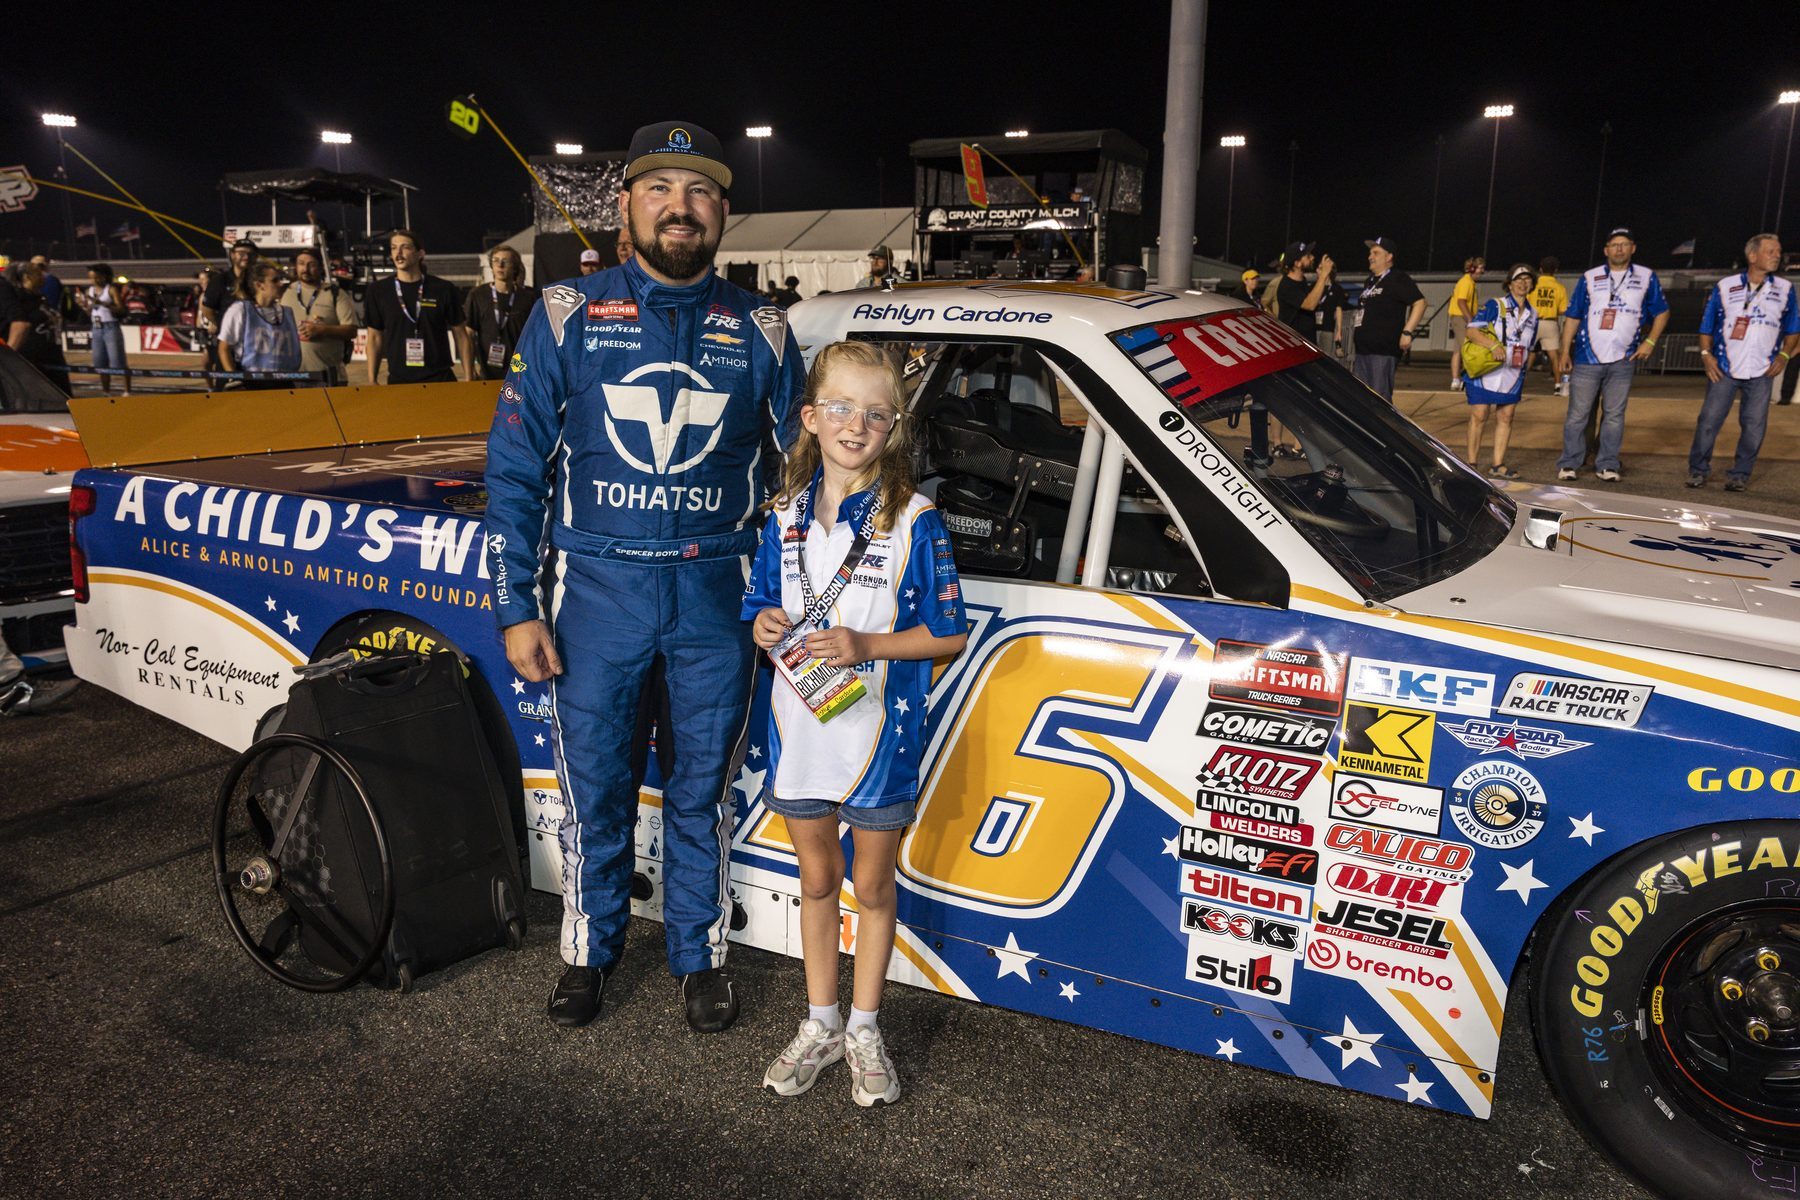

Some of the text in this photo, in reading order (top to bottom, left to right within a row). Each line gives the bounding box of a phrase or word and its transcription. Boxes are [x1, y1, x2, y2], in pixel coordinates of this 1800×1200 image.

[450, 100, 480, 134] 20
[948, 210, 987, 219] GRANT
[989, 209, 1036, 219] COUNTY
[590, 306, 636, 314] CRAFTSMAN
[703, 313, 743, 330] FRE
[853, 303, 1053, 326] Ashlyn Cardone
[144, 329, 164, 350] 17
[585, 324, 642, 334] GOODYEAR
[599, 340, 641, 349] FREEDOM
[699, 343, 747, 354] CHEVROLET
[699, 352, 748, 369] AMTHOR
[1175, 429, 1282, 528] DROPLIGHT
[593, 479, 722, 512] TOHATSU
[114, 477, 146, 526] A
[162, 481, 399, 564] CHILD'S
[946, 514, 991, 530] FREEDOM
[946, 523, 990, 535] WARRANTY
[615, 548, 654, 557] SPENCER
[141, 537, 492, 612] ALICE & ARNOLD AMTHOR FOUNDA
[497, 556, 510, 605] TOHATSU
[853, 574, 888, 586] DESNUDA
[809, 578, 842, 625] NASCAR
[95, 628, 280, 690] Nor-Cal Equipment
[1265, 651, 1308, 665] NASCAR
[138, 667, 246, 706] RENTALS
[1244, 665, 1339, 694] AFTSMAN
[1352, 663, 1488, 707] SKF
[1549, 681, 1631, 706] NASCAR
[1247, 691, 1302, 706] TRUCK SERIES
[1510, 696, 1630, 722] RACE TRUCK
[1203, 711, 1329, 748] COMETIC
[1209, 731, 1257, 743] GASKET
[1463, 735, 1551, 753] RaceCar Bodies
[1464, 724, 1562, 745] FIVE STAR
[1210, 751, 1313, 791] KLOTZ
[1341, 756, 1424, 780] KENNAMETAL
[1462, 764, 1540, 797] CHAMPION
[1248, 785, 1295, 799] SYNTHETICS
[1333, 789, 1439, 818] XCELDYNE
[1201, 792, 1295, 824] LINCOLN
[1220, 815, 1302, 843] WELDERS
[1455, 811, 1537, 846] IRRIGATION
[1182, 827, 1268, 873] Holley
[1325, 825, 1472, 871] CALICO
[1334, 865, 1460, 909] DART
[1396, 862, 1468, 882] COATINGS
[1188, 869, 1303, 915] tilton
[1185, 902, 1299, 952] KOOKS
[1318, 900, 1453, 949] JESEL
[1571, 837, 1800, 1018] GOODYEA
[1325, 926, 1436, 957] SHAFT ROCKER ARMS
[1195, 954, 1282, 997] Stilo
[1346, 950, 1453, 991] brembo
[1654, 989, 1663, 1022] Bassett
